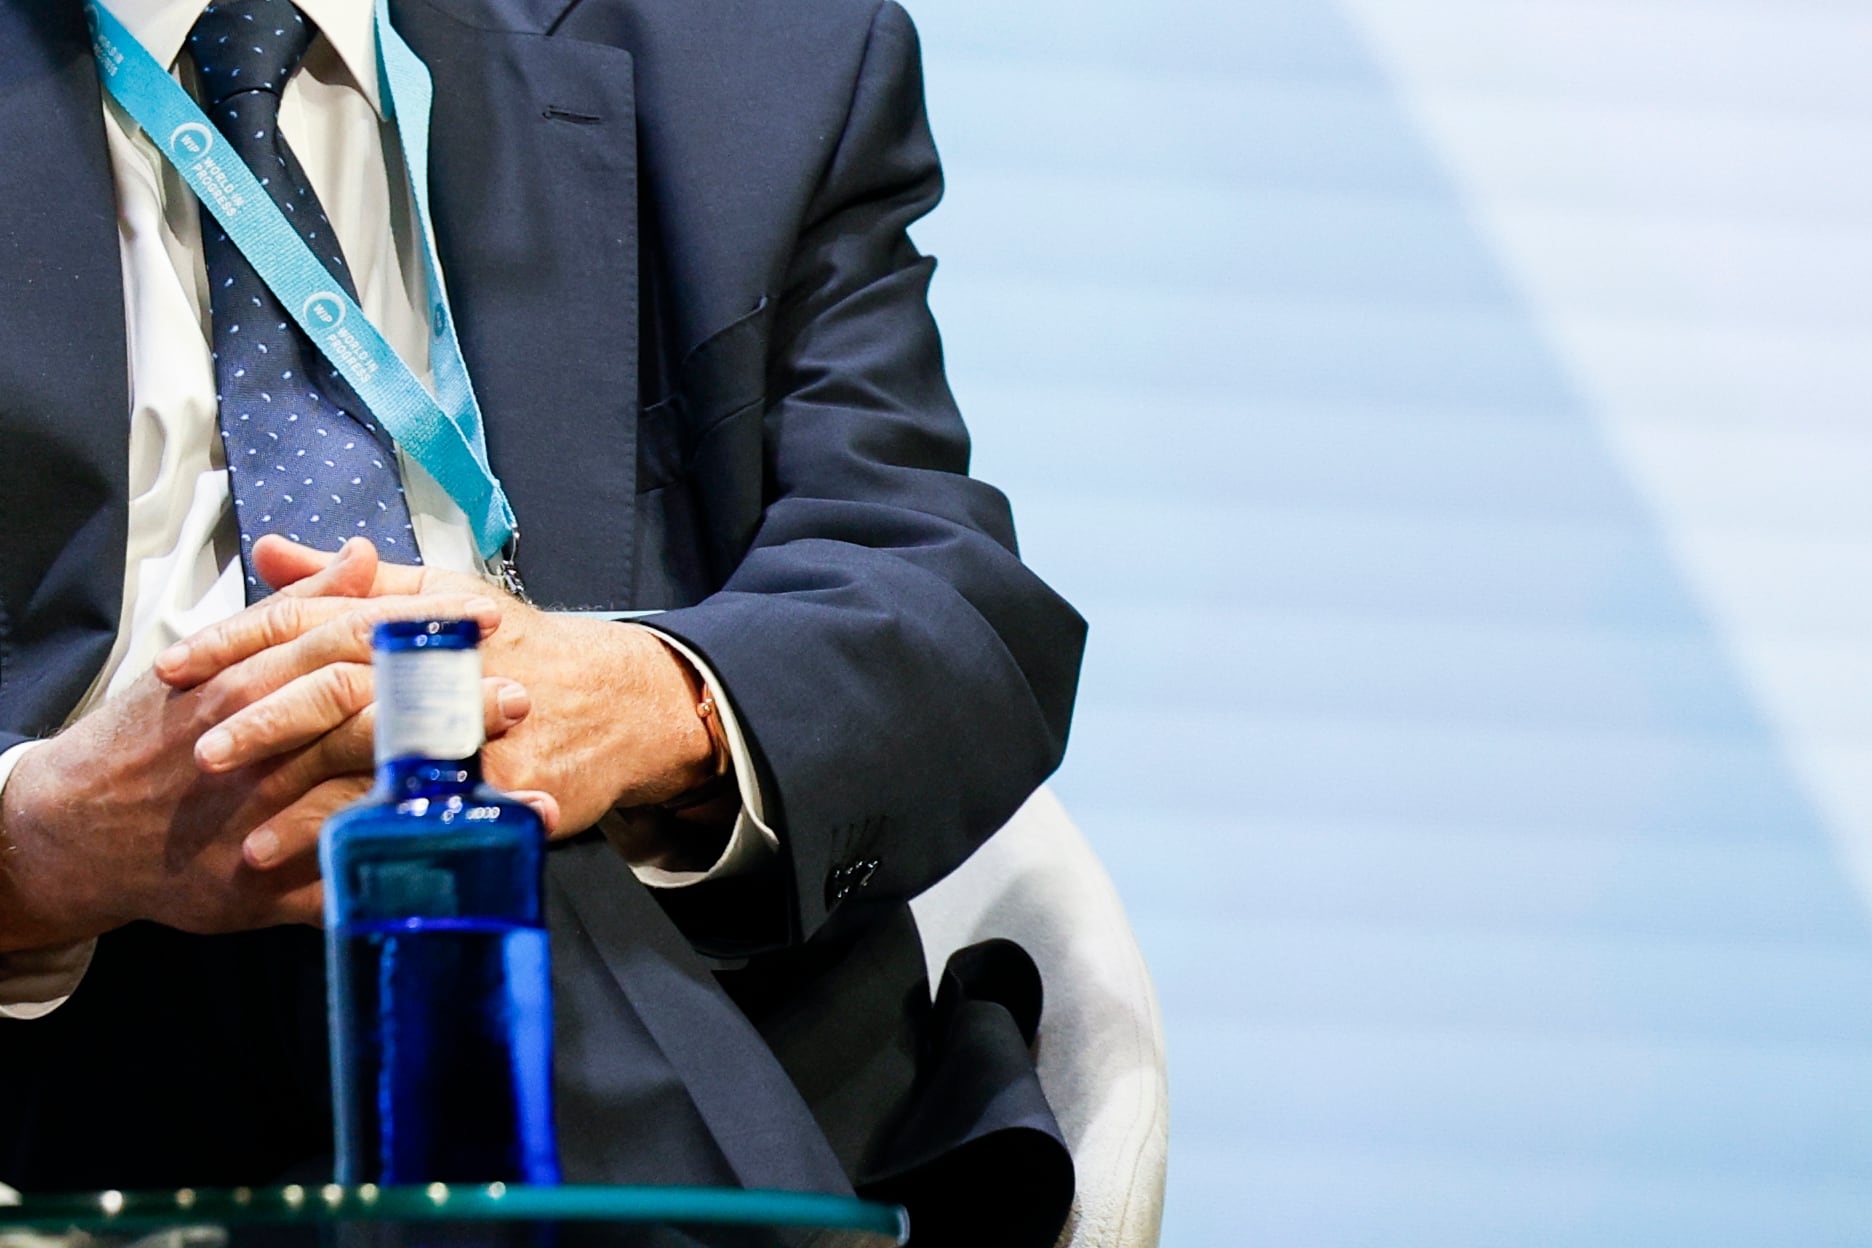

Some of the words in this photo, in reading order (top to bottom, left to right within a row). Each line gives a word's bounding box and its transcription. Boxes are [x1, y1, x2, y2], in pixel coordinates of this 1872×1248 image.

[181, 135, 200, 152] WIP
[192, 163, 237, 216] PROGRESS
[204, 156, 235, 193] WORLD
[313, 303, 333, 323] WIP
[327, 334, 371, 383] PROGRESS
[337, 327, 369, 360] WORLD
